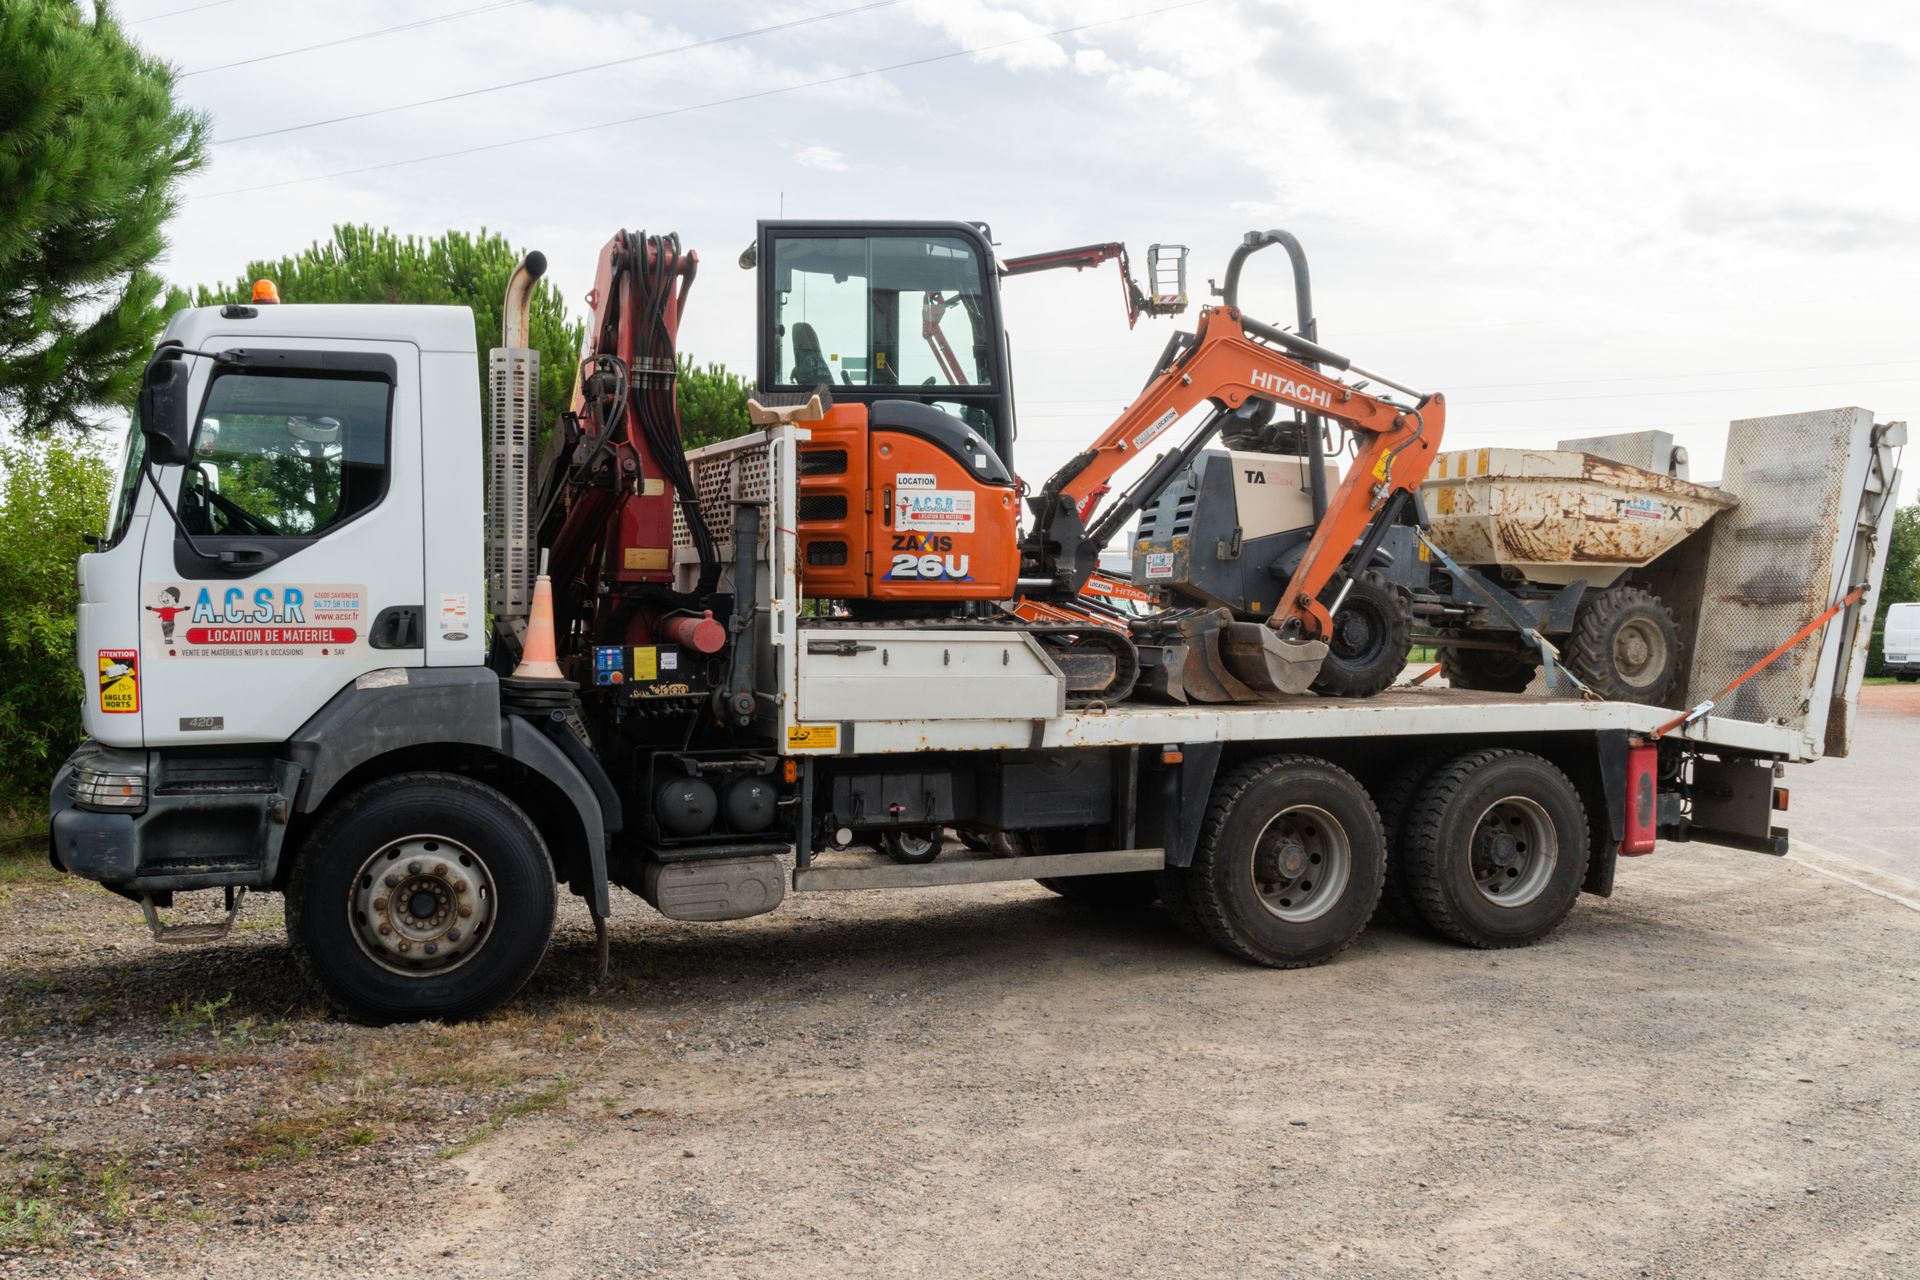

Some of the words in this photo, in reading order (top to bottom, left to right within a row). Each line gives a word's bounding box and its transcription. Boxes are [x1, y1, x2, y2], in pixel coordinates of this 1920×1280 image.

[1250, 368, 1332, 408] HITACHI
[898, 477, 935, 485] LOCATION
[1244, 470, 1266, 484] TA
[892, 532, 952, 552] ZAXIS
[891, 554, 969, 582] 26U
[191, 587, 306, 623] A.C.S.R
[315, 611, 359, 620] www.acsr.fr
[207, 629, 260, 642] LOCATION
[265, 629, 279, 642] DE
[283, 629, 335, 642] MATERIEL
[190, 718, 214, 727] 420
